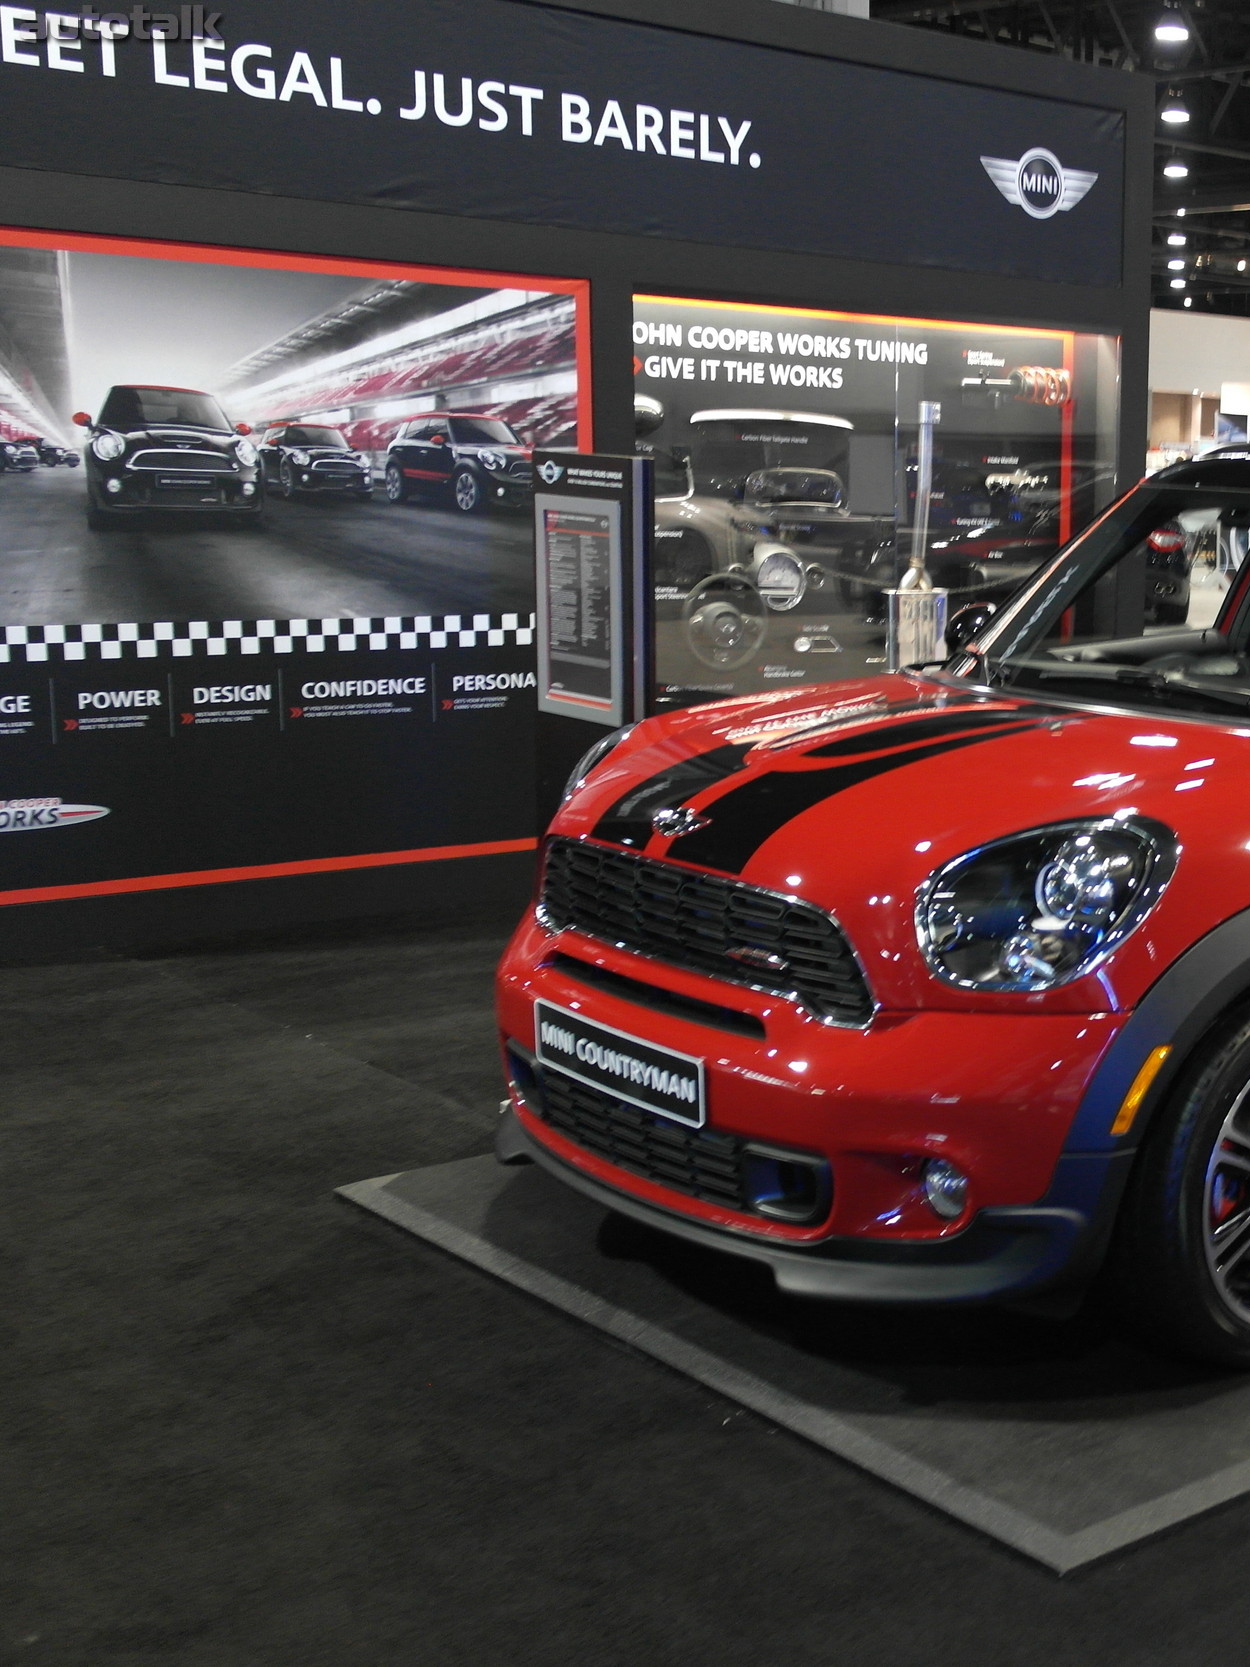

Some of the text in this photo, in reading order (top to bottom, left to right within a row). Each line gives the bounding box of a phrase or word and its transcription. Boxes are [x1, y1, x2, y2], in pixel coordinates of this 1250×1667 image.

[0, 5, 762, 169] EET LEGAL. JUST BARELY.
[1022, 172, 1058, 195] MINI
[687, 325, 773, 353] COOPER
[777, 332, 851, 359] WORKS
[855, 339, 928, 365] TUNING
[644, 356, 843, 389] GIVE IT THE WORKS
[301, 677, 426, 698] CONFIDENCE
[452, 672, 537, 692] PERSONA
[78, 689, 162, 710] POWER
[193, 684, 272, 705] DESIGN
[8, 798, 60, 809] COOPER
[541, 1021, 696, 1104] MINI COUNTRYMAN
